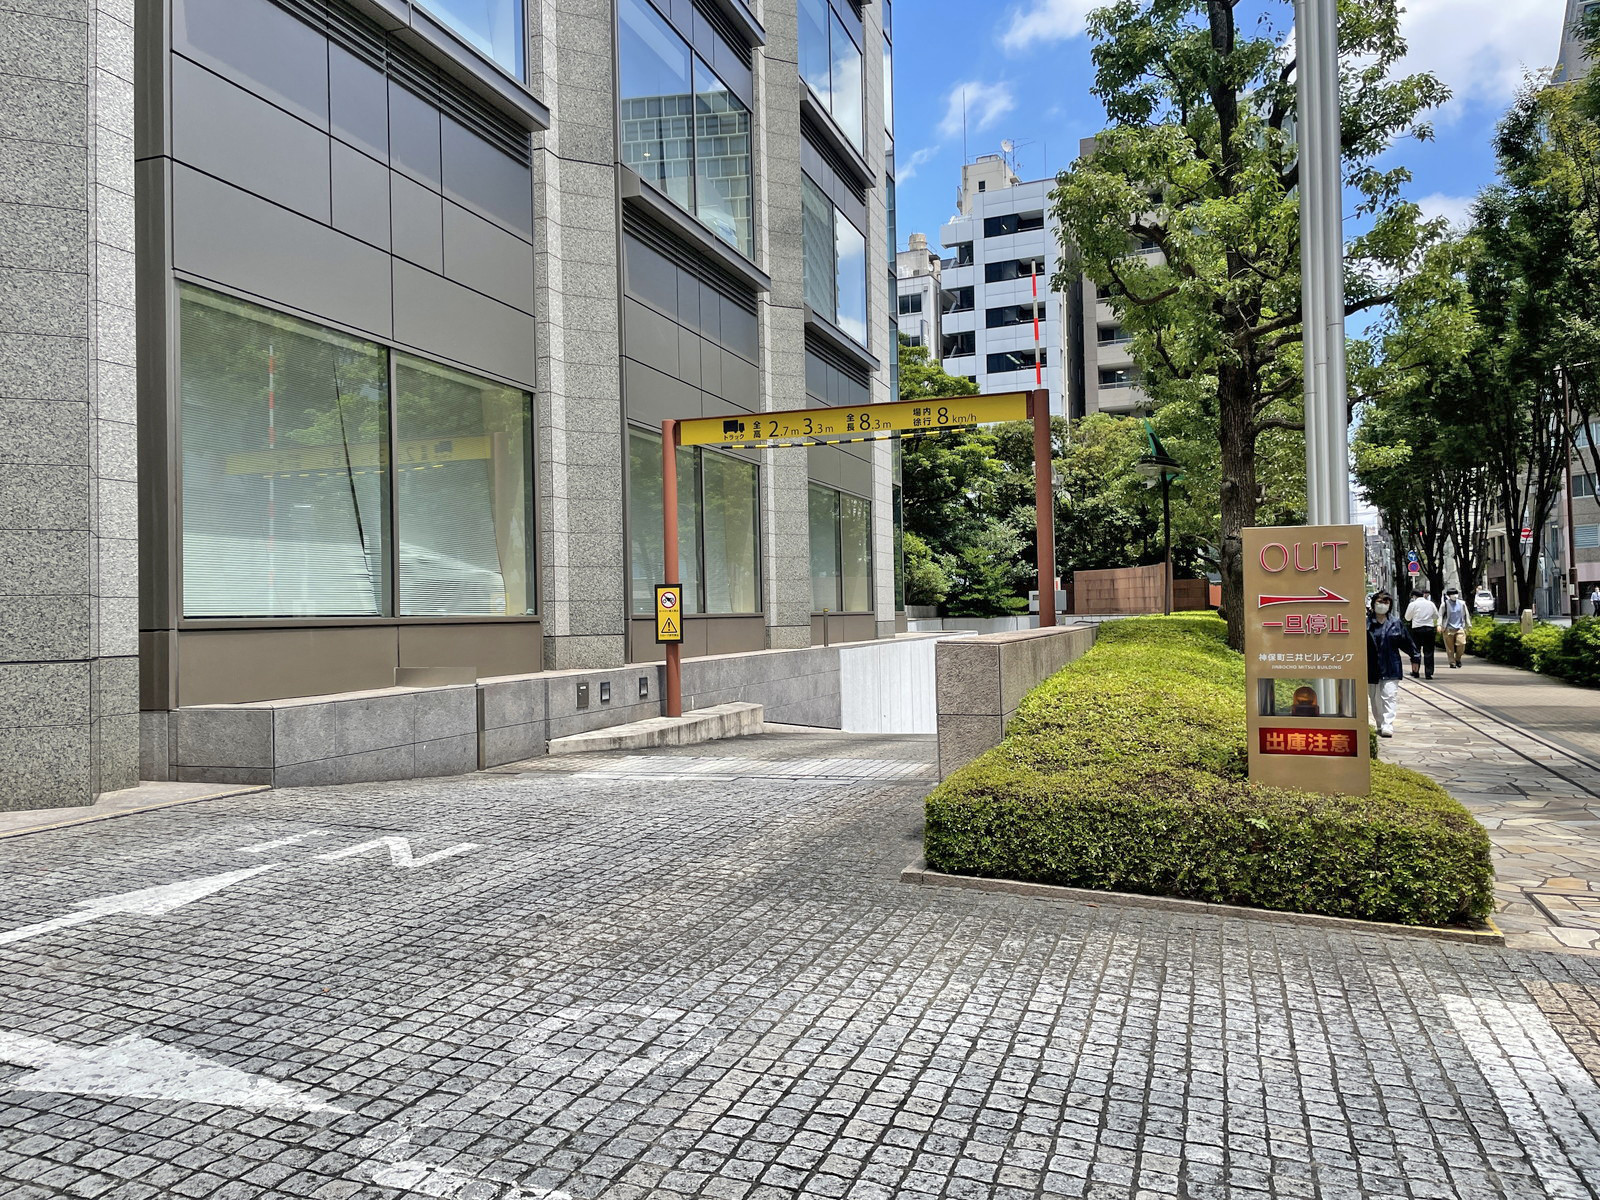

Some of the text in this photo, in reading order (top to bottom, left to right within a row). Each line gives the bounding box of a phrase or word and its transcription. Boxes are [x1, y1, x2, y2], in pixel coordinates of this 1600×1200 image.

[913, 407, 931, 416] 場内
[846, 413, 855, 431] 全長
[913, 417, 931, 427] 徐行
[723, 433, 745, 441] トラック
[1259, 542, 1349, 573] OUT
[1262, 613, 1350, 635] 一旦停止
[1258, 652, 1355, 662] 神保町三井ビルディング
[1265, 731, 1351, 753] 出庫注意
